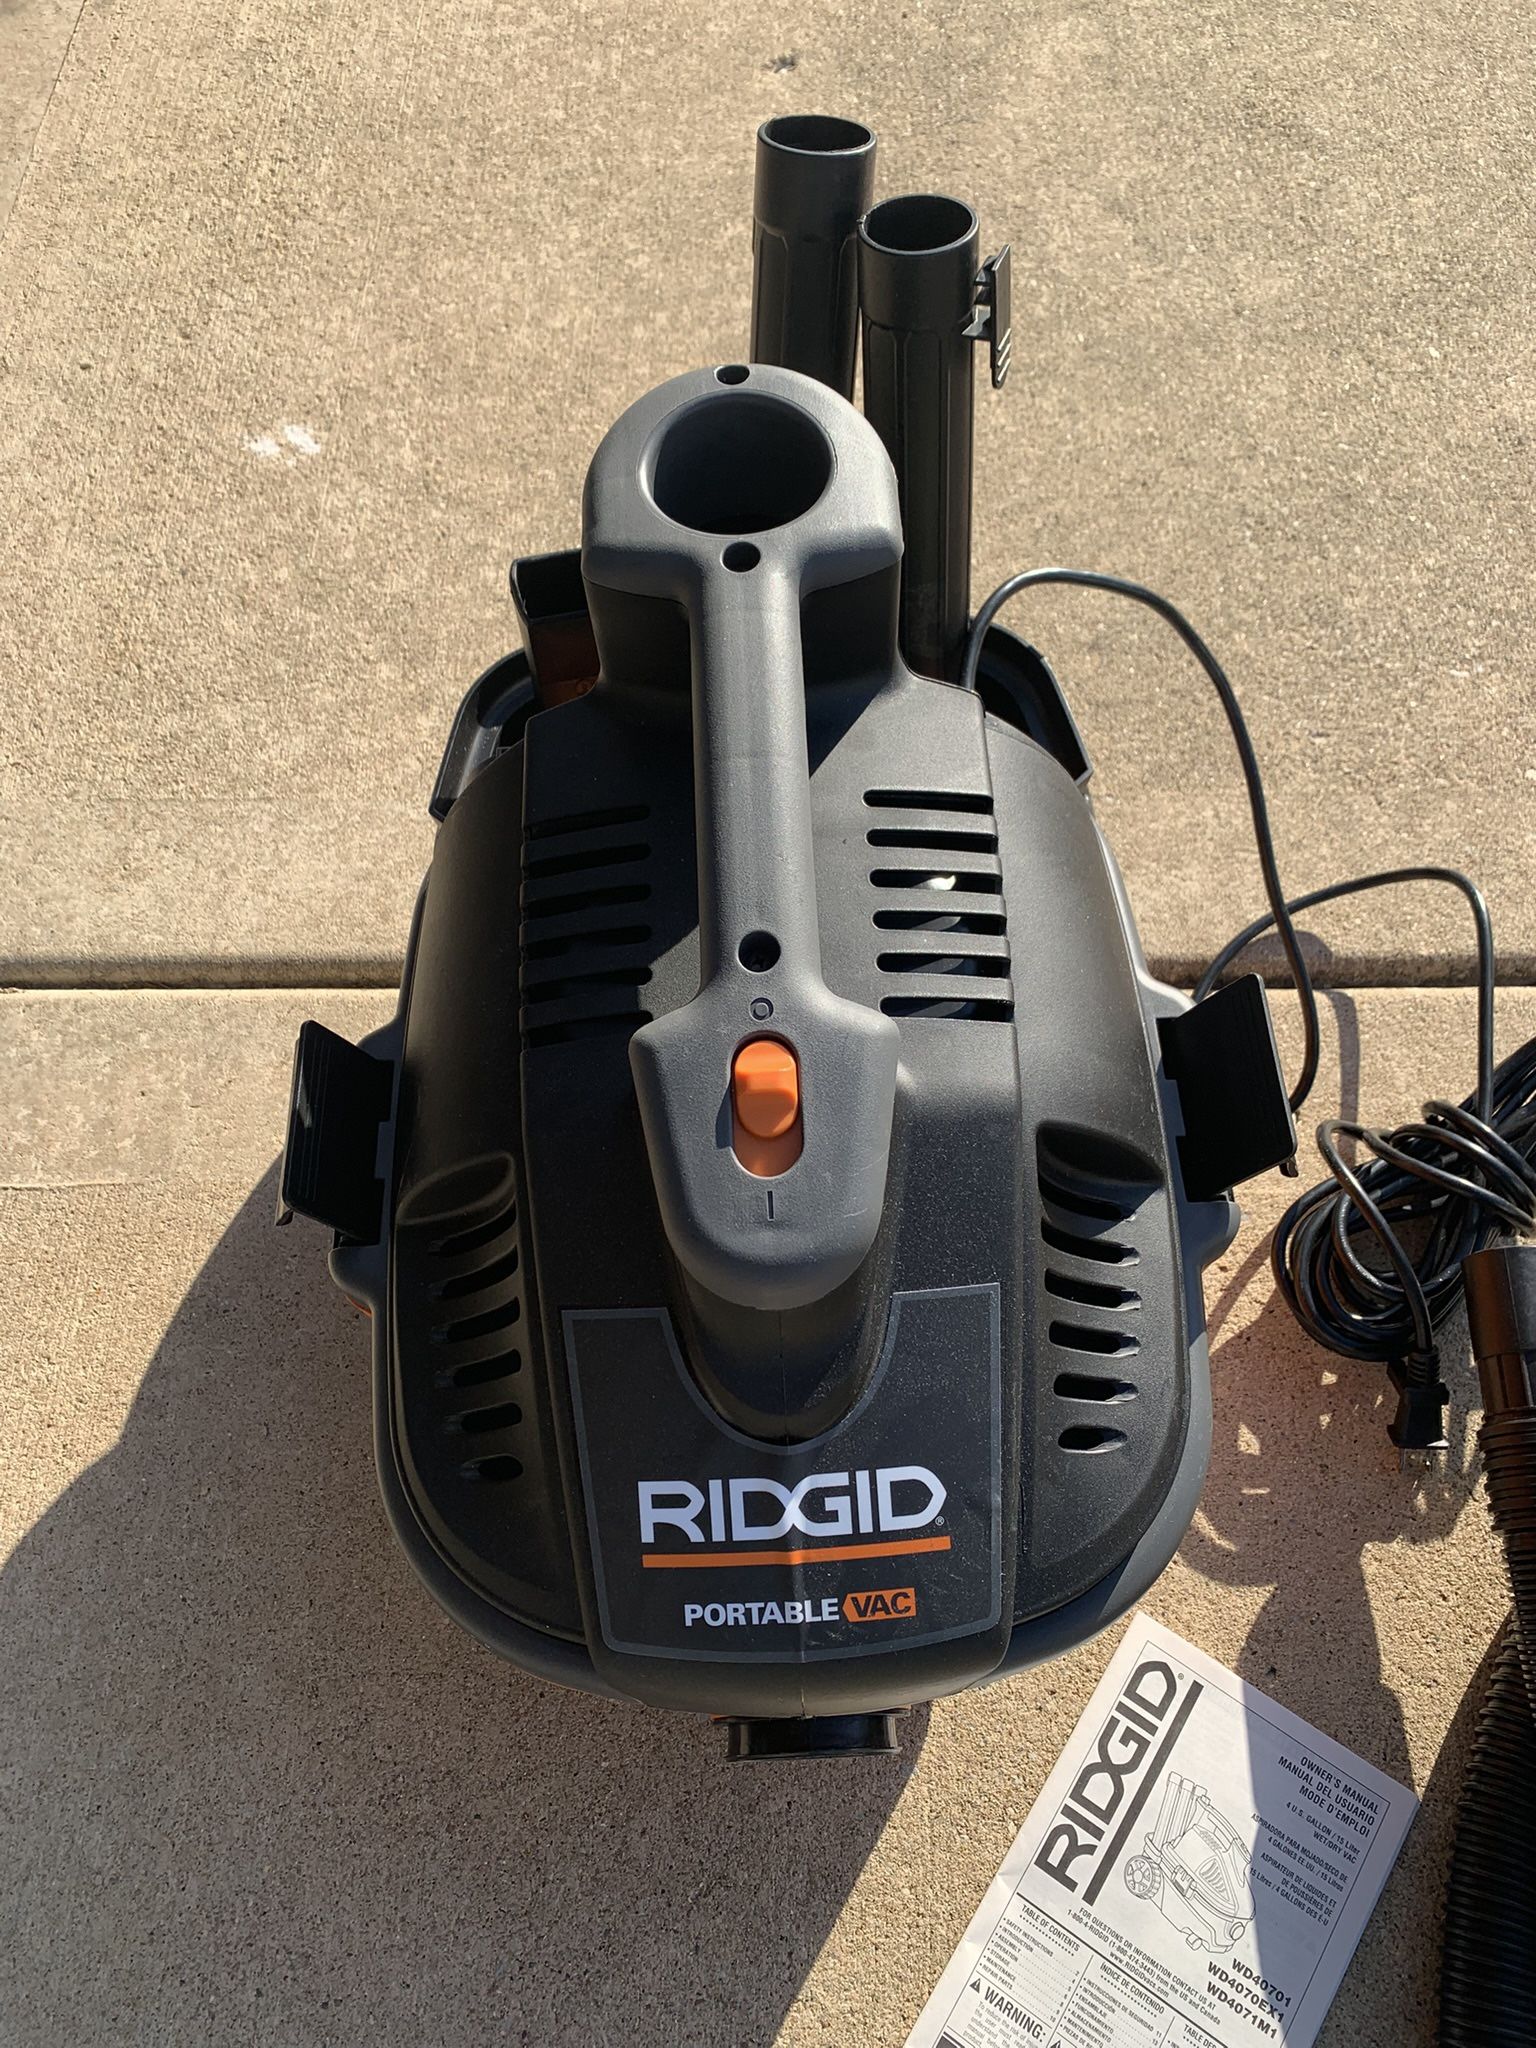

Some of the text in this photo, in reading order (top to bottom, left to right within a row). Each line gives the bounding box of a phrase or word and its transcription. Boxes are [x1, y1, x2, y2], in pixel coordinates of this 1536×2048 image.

[637, 1465, 947, 1543] RIDGID
[684, 1591, 912, 1627] PORTABLE VAC
[1034, 1660, 1177, 1893] RIDGID
[1277, 1755, 1375, 1826] MANUAL DEL USUARIO
[1300, 1756, 1380, 1815] OWNER'S MANUAL
[1291, 1804, 1304, 1817] U.S.
[1305, 1814, 1331, 1836] GALLON
[1335, 1835, 1344, 1845] 15
[1344, 1841, 1360, 1855] Liter
[1298, 1784, 1370, 1838] MODE D'EMPLOI
[1250, 1812, 1347, 1883] ASPIRADORA PARA MOJADO/SECO DE
[1272, 1839, 1297, 1860] GALONES
[1319, 1871, 1328, 1881] 15
[1327, 1876, 1344, 1892] Litros
[1312, 1830, 1356, 1864] WET/DRY VAC
[1248, 1867, 1256, 1876] 15
[1256, 1872, 1272, 1887] Litres
[1279, 1888, 1306, 1911] GALLONS
[1305, 1906, 1317, 1919] DES
[1260, 1851, 1336, 1908] ASPIRATEUR DE LIQUIDES ET
[1280, 1877, 1289, 1887] DE
[1323, 1907, 1332, 1917] DE
[993, 1941, 1018, 1962] OPERATION
[997, 1933, 1021, 1953] ASSEMBLY
[1001, 1926, 1033, 1952] INTRODUCTION
[1005, 1918, 1022, 1934] SAFETY
[1021, 1930, 1053, 1957] INSTRUCTIONS
[1021, 1904, 1080, 1952] TABLE OF CONTENTS
[985, 1956, 1016, 1982] MAINTENANCE
[1078, 1906, 1216, 2011] FOR QUESTIONS OR INFORMATION CONTACT US AT
[1230, 1958, 1291, 2008] WD40701
[1099, 1960, 1165, 2014] ÍNDICE DE CONTENIDO
[1155, 1973, 1169, 1987] from
[1168, 1983, 1179, 1994] the
[1178, 1990, 1188, 2001] US
[1187, 1997, 1199, 2009] and
[1199, 2005, 1221, 2025] Canada
[1205, 1981, 1277, 2039] WD4071M1
[1206, 1961, 1284, 2023] WD4070EX1
[982, 1985, 1048, 2042] WARNING:
[1183, 2023, 1203, 2042] TABLE
